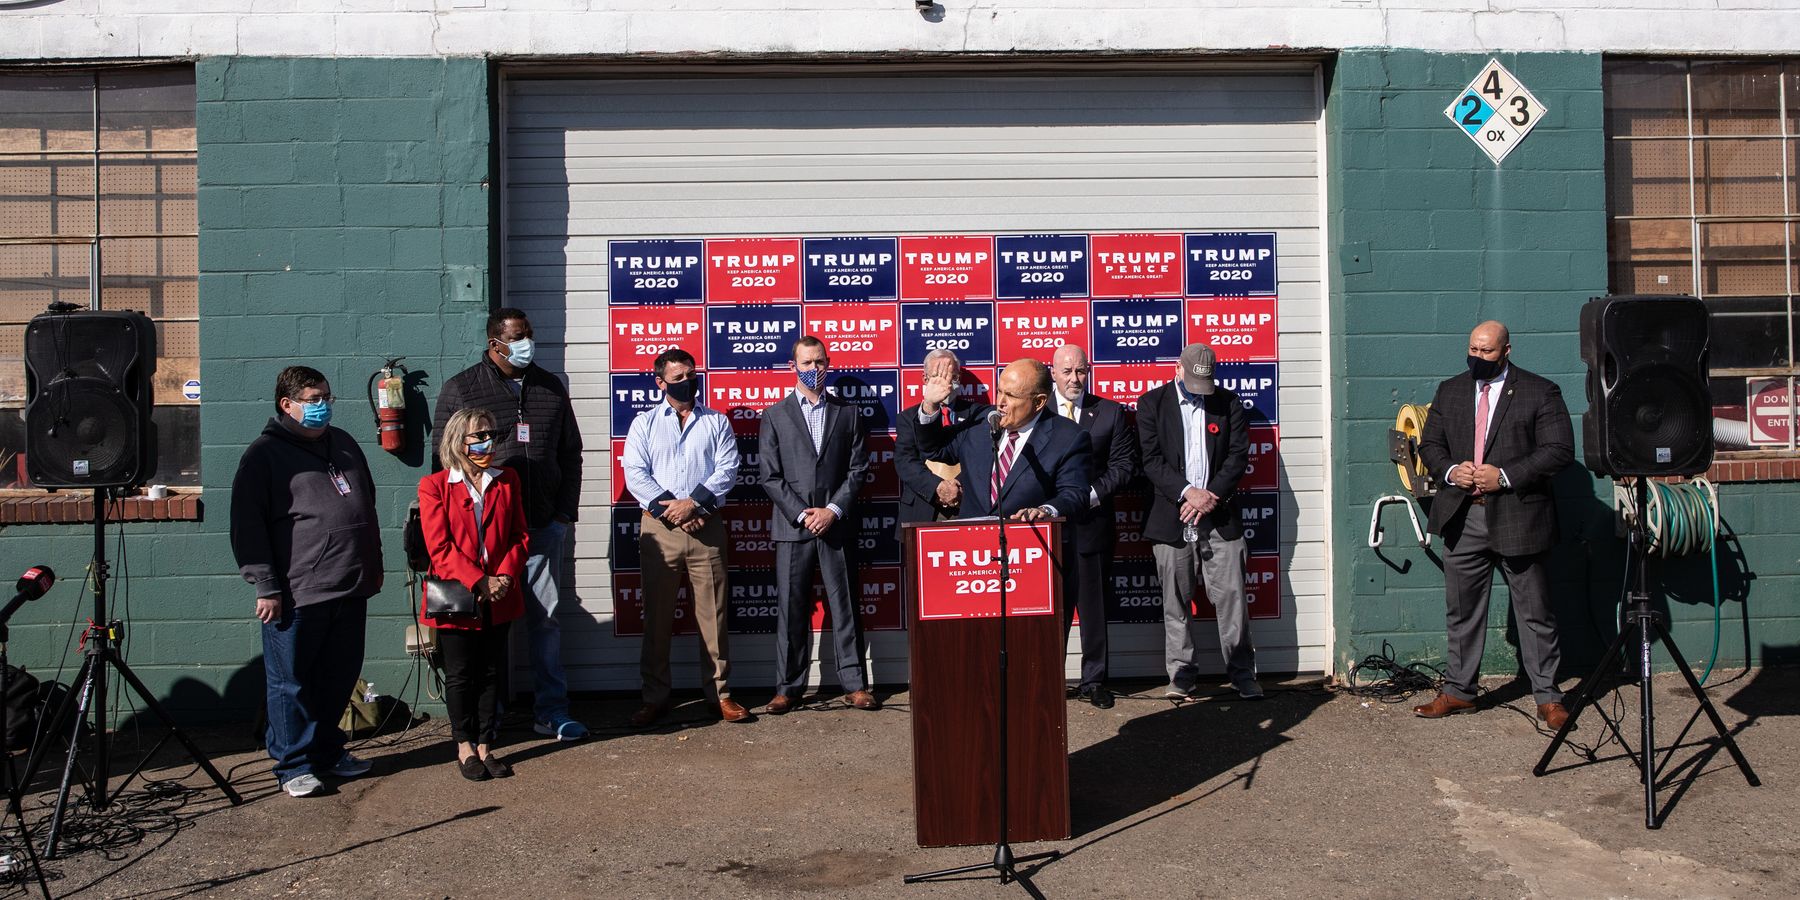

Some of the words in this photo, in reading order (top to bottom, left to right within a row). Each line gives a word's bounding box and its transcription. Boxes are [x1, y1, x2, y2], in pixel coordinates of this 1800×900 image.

[1483, 70, 1503, 100] 4
[1462, 95, 1482, 125] 2
[1510, 96, 1530, 126] 3
[1486, 130, 1505, 141] OX
[712, 255, 795, 267] TRUMP
[809, 254, 892, 266] TRUMP
[905, 252, 988, 264] TRUMP
[1001, 251, 1083, 263] TRUMP
[1098, 252, 1175, 264] TRUMP
[1190, 249, 1270, 261] TRUMP
[614, 256, 698, 268] TRUMP
[829, 275, 872, 285] 2020
[925, 274, 968, 284] 2020
[1021, 272, 1064, 282] 2020
[1210, 270, 1252, 280] 2020
[634, 278, 678, 288] 2020
[732, 276, 776, 287] 2020
[810, 320, 892, 332] TRUMP
[906, 318, 988, 330] TRUMP
[1002, 316, 1084, 329] TRUMP
[1097, 315, 1178, 327] TRUMP
[1191, 314, 1271, 326] TRUMP
[616, 323, 699, 335] TRUMP
[712, 321, 796, 333] TRUMP
[830, 341, 873, 351] 2020
[926, 339, 969, 350] 2020
[1022, 338, 1065, 348] 2020
[1117, 336, 1159, 346] 2020
[1211, 335, 1252, 345] 2020
[733, 343, 776, 353] 2020
[826, 385, 893, 398] RUMP
[732, 585, 778, 597] RUM
[812, 583, 895, 596] TMP
[1120, 596, 1162, 607] 2020
